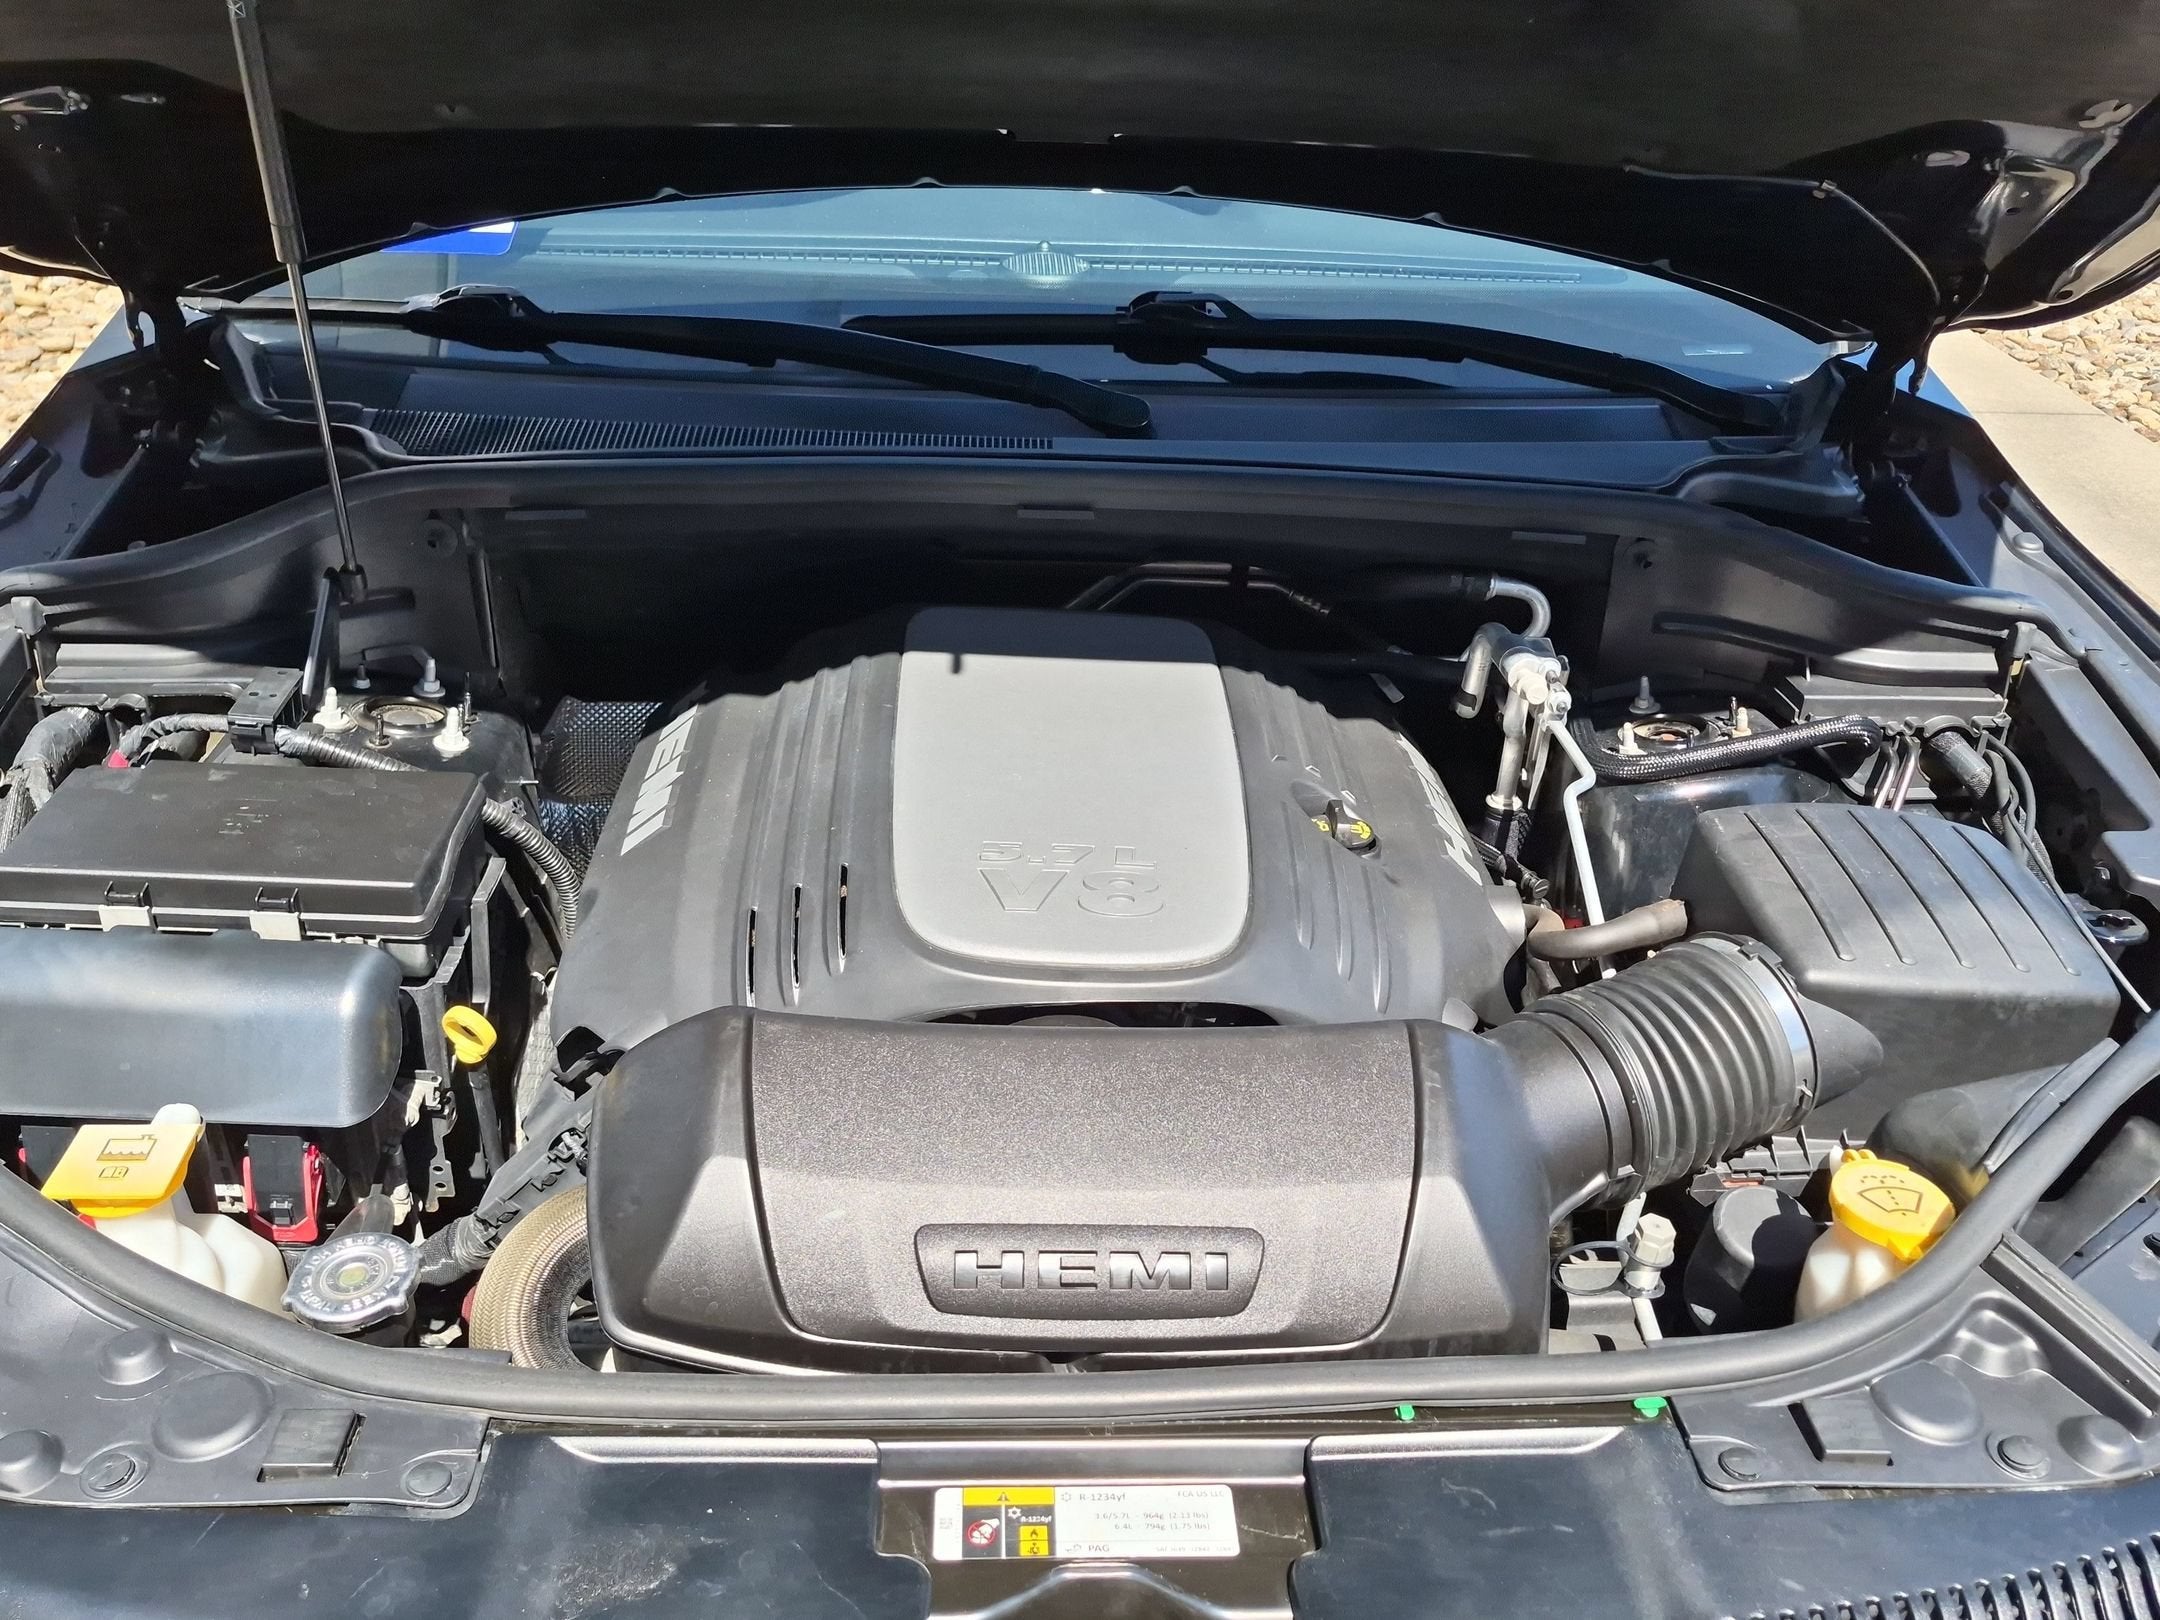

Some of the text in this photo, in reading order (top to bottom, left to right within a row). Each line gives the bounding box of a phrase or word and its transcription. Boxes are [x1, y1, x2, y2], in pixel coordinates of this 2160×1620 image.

[978, 840, 1157, 870] 5.7L
[977, 868, 1165, 918] V8
[954, 1251, 1229, 1290] HEMI
[1079, 1493, 1126, 1503] R-1234yf
[1088, 1544, 1110, 1552] PAG
